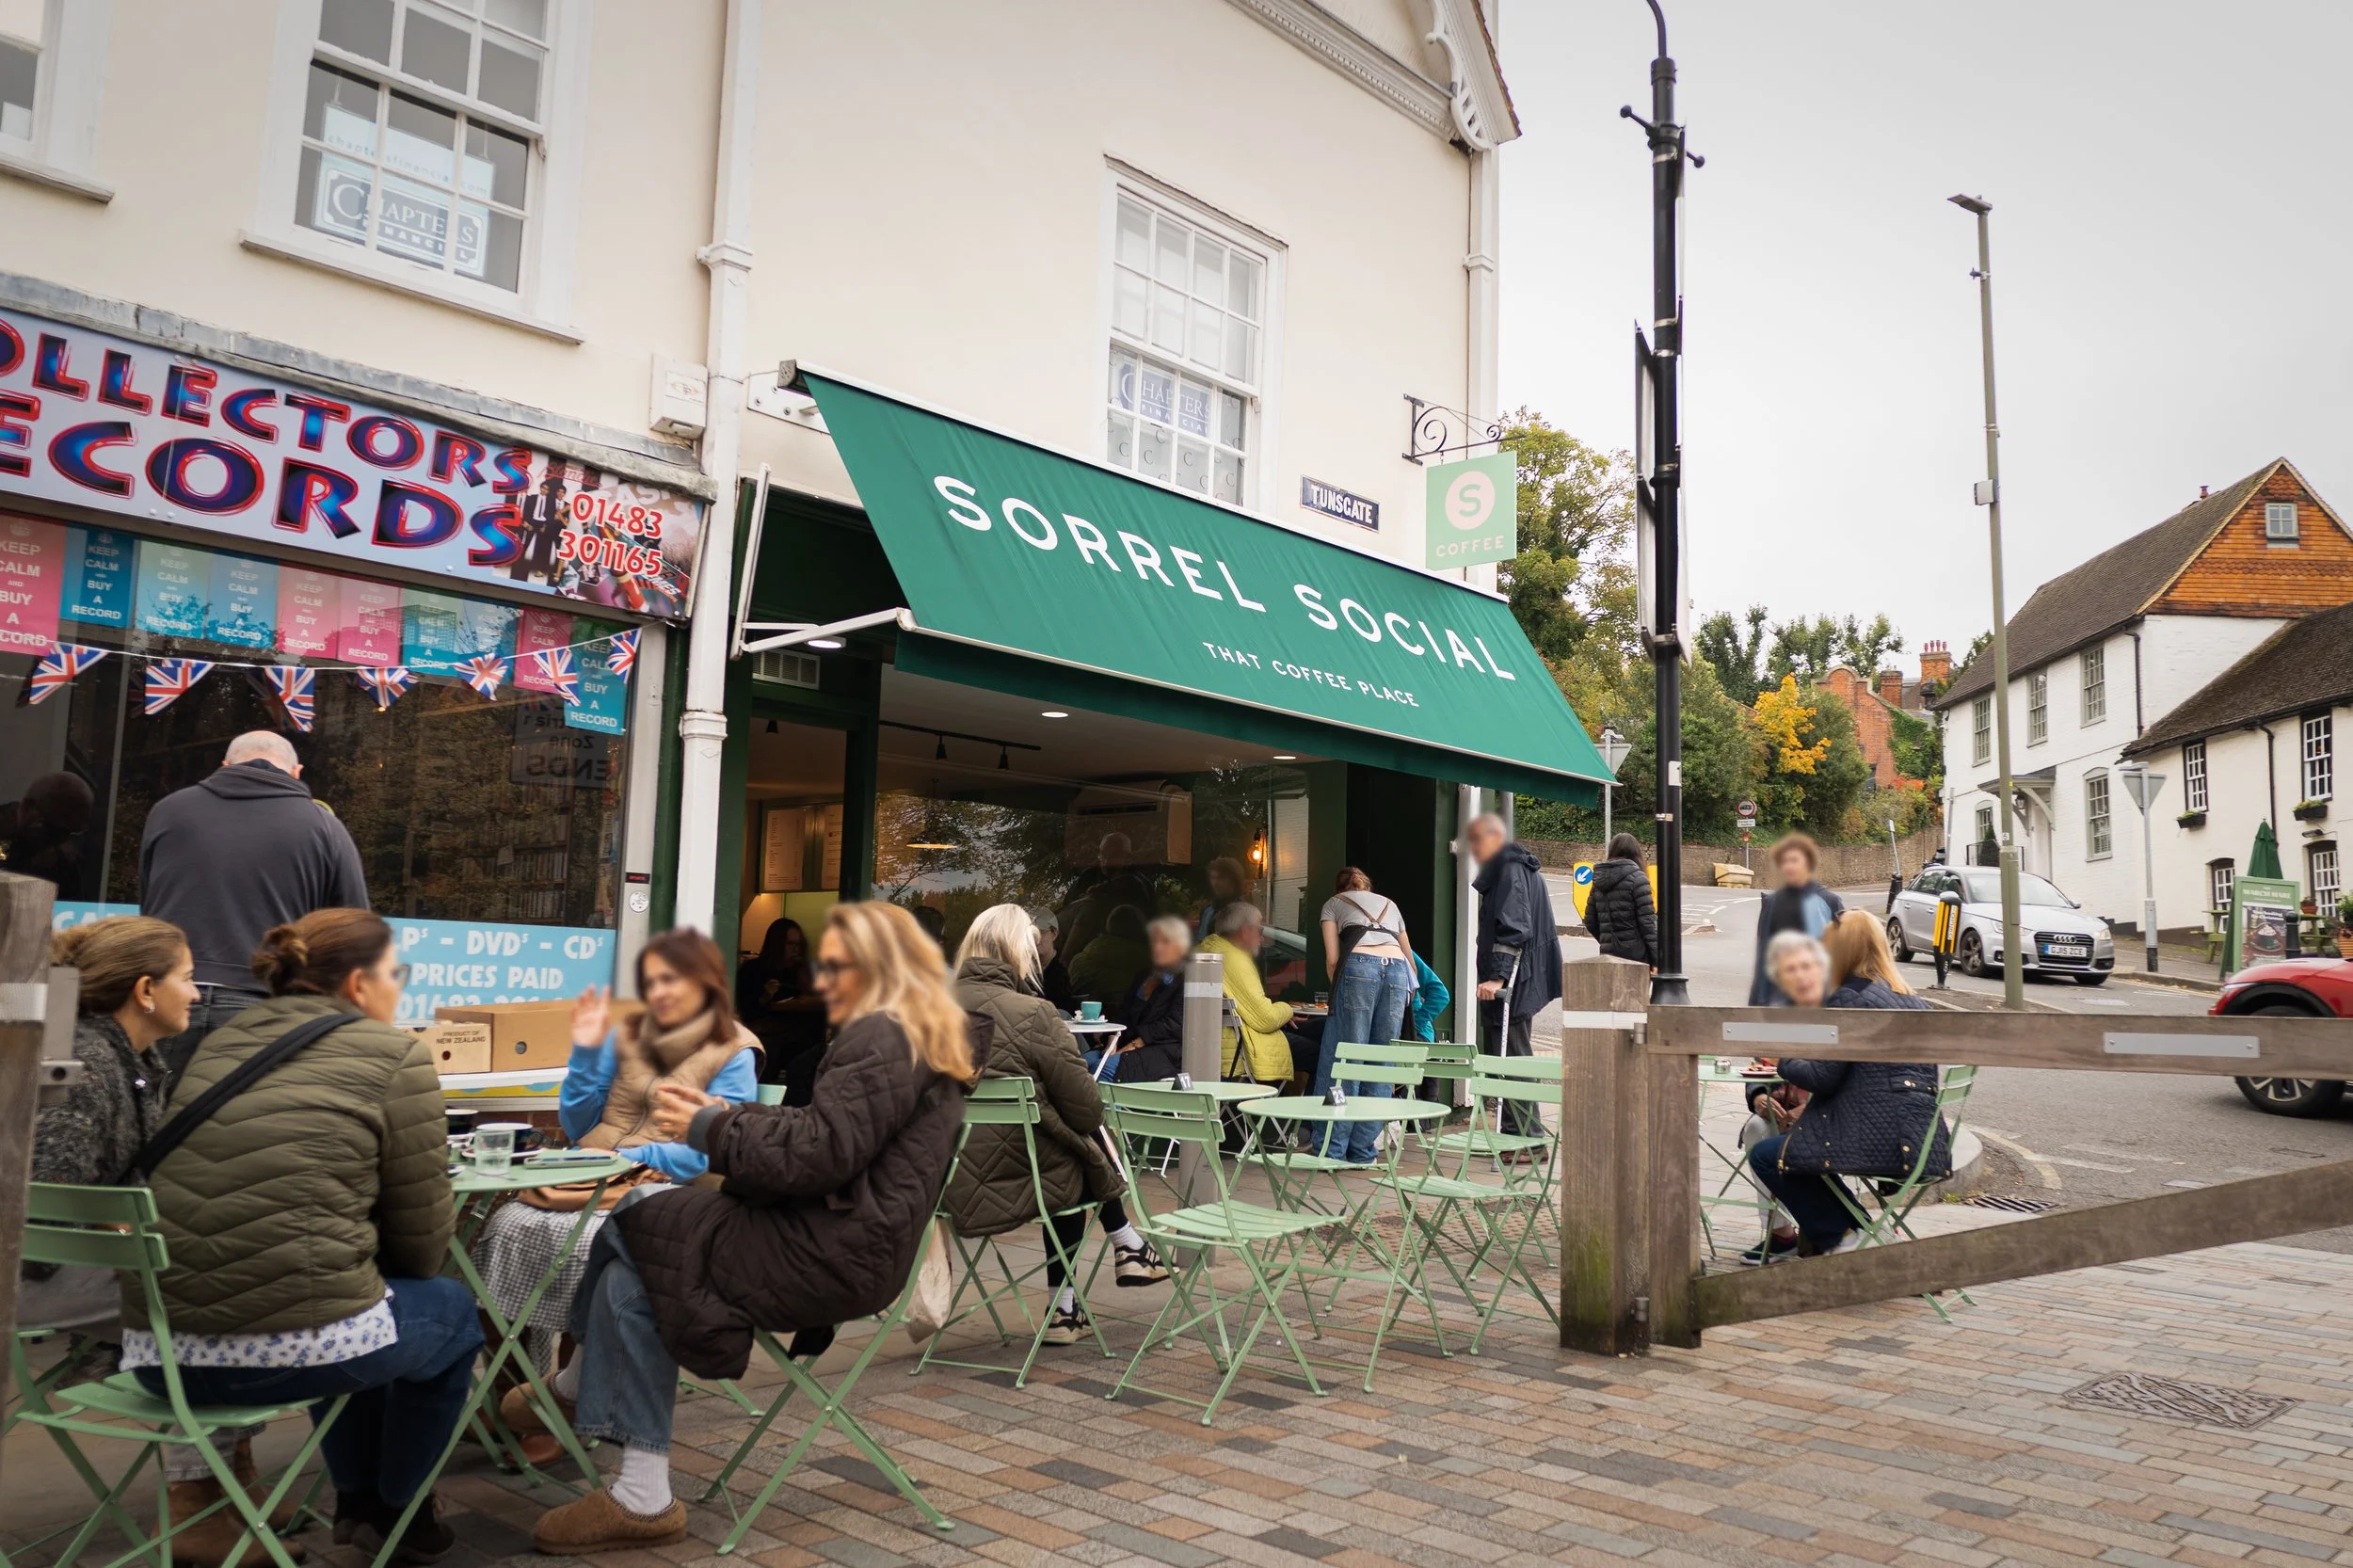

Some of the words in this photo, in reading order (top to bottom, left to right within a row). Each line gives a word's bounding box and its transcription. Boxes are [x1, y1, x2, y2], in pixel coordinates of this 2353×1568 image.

[1310, 484, 1373, 524] TUNSGATE
[1458, 483, 1482, 518] S
[571, 493, 664, 539] 01483
[88, 545, 120, 557] KEEP
[557, 529, 664, 576] 301165
[1435, 535, 1505, 558] COFFEE
[86, 558, 119, 572] CALM
[157, 570, 188, 584] CALM
[933, 474, 1266, 613] SORREL
[1293, 583, 1516, 681] SOCIAL
[88, 579, 113, 591] BUY
[228, 582, 259, 596] CALM
[0, 590, 33, 605] BUY
[93, 595, 103, 604] A
[293, 595, 324, 607] CALM
[72, 604, 122, 620] RECORD
[231, 601, 253, 613] BUY
[6, 612, 20, 625] A
[145, 616, 193, 631] RECORD
[295, 614, 317, 626] BUY
[216, 626, 263, 642] RECORD
[359, 625, 381, 635] BUY
[532, 623, 556, 634] KEEP
[284, 636, 328, 651] RECORD
[364, 638, 374, 648] A
[530, 635, 555, 647] CALM
[347, 647, 389, 662] RECORD
[522, 674, 556, 687] RECOR
[1202, 641, 1260, 671] THAT
[1272, 659, 1353, 692] COFFEE
[1358, 680, 1420, 709] PLACE
[584, 680, 609, 696] BUY
[589, 699, 600, 711] A
[569, 711, 618, 728] RECORD
[410, 962, 498, 988] PRICES
[506, 966, 564, 989] PAID
[1179, 1075, 1192, 1089] 17
